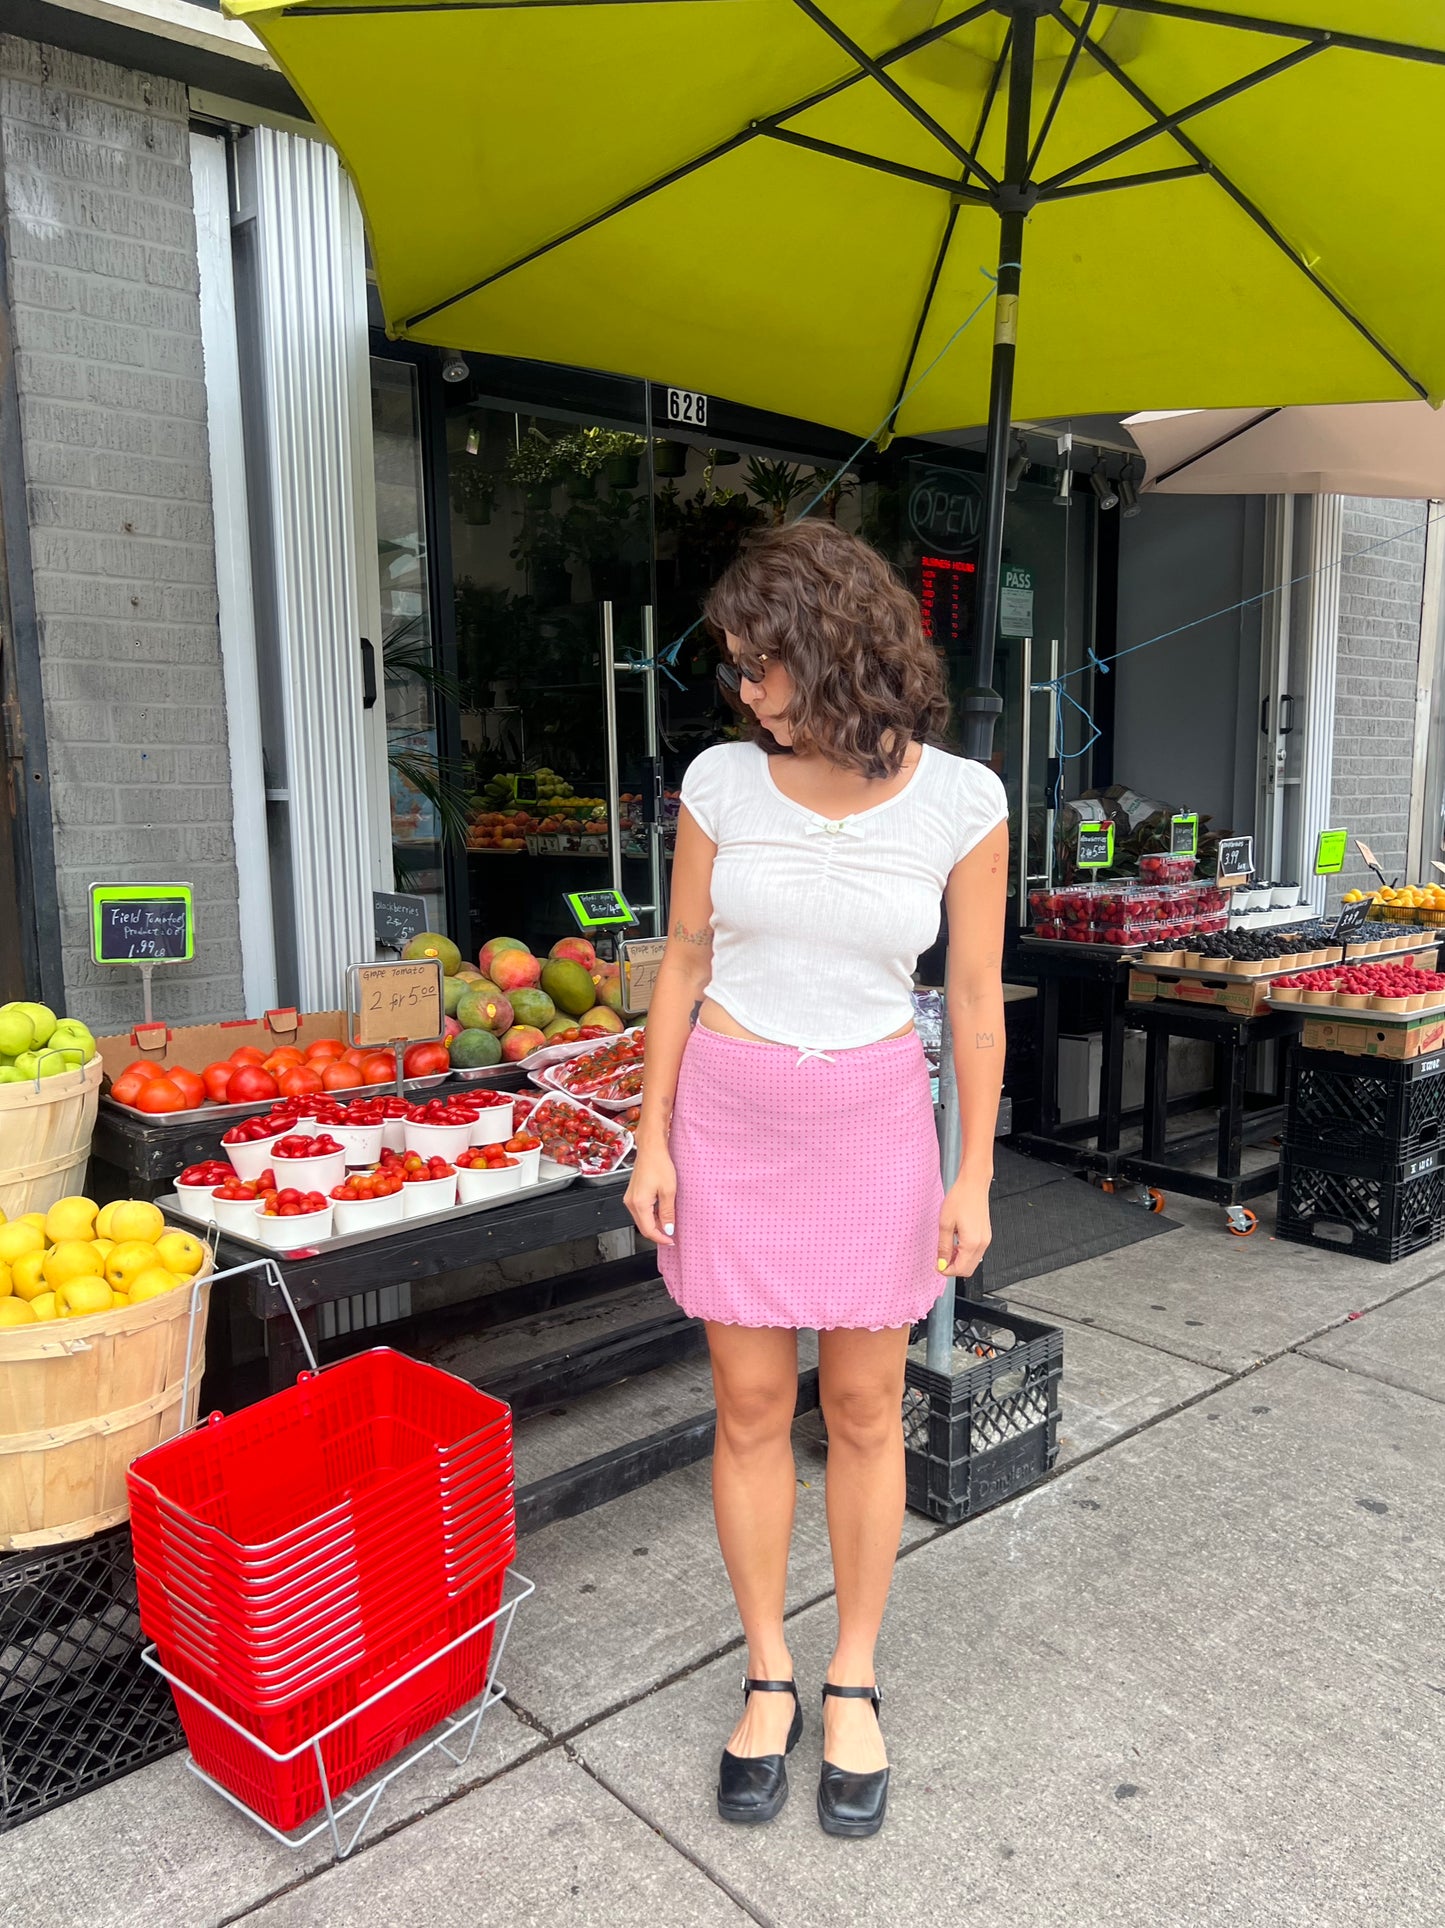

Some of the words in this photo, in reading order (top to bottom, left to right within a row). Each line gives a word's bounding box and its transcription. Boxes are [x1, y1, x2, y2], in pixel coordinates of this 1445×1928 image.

[670, 390, 705, 423] 628
[913, 488, 982, 536] OPEN
[1006, 571, 1031, 589] PASS
[111, 908, 142, 926] Field
[128, 940, 155, 958] 1.99
[634, 964, 645, 987] 2
[369, 990, 382, 1011] 2
